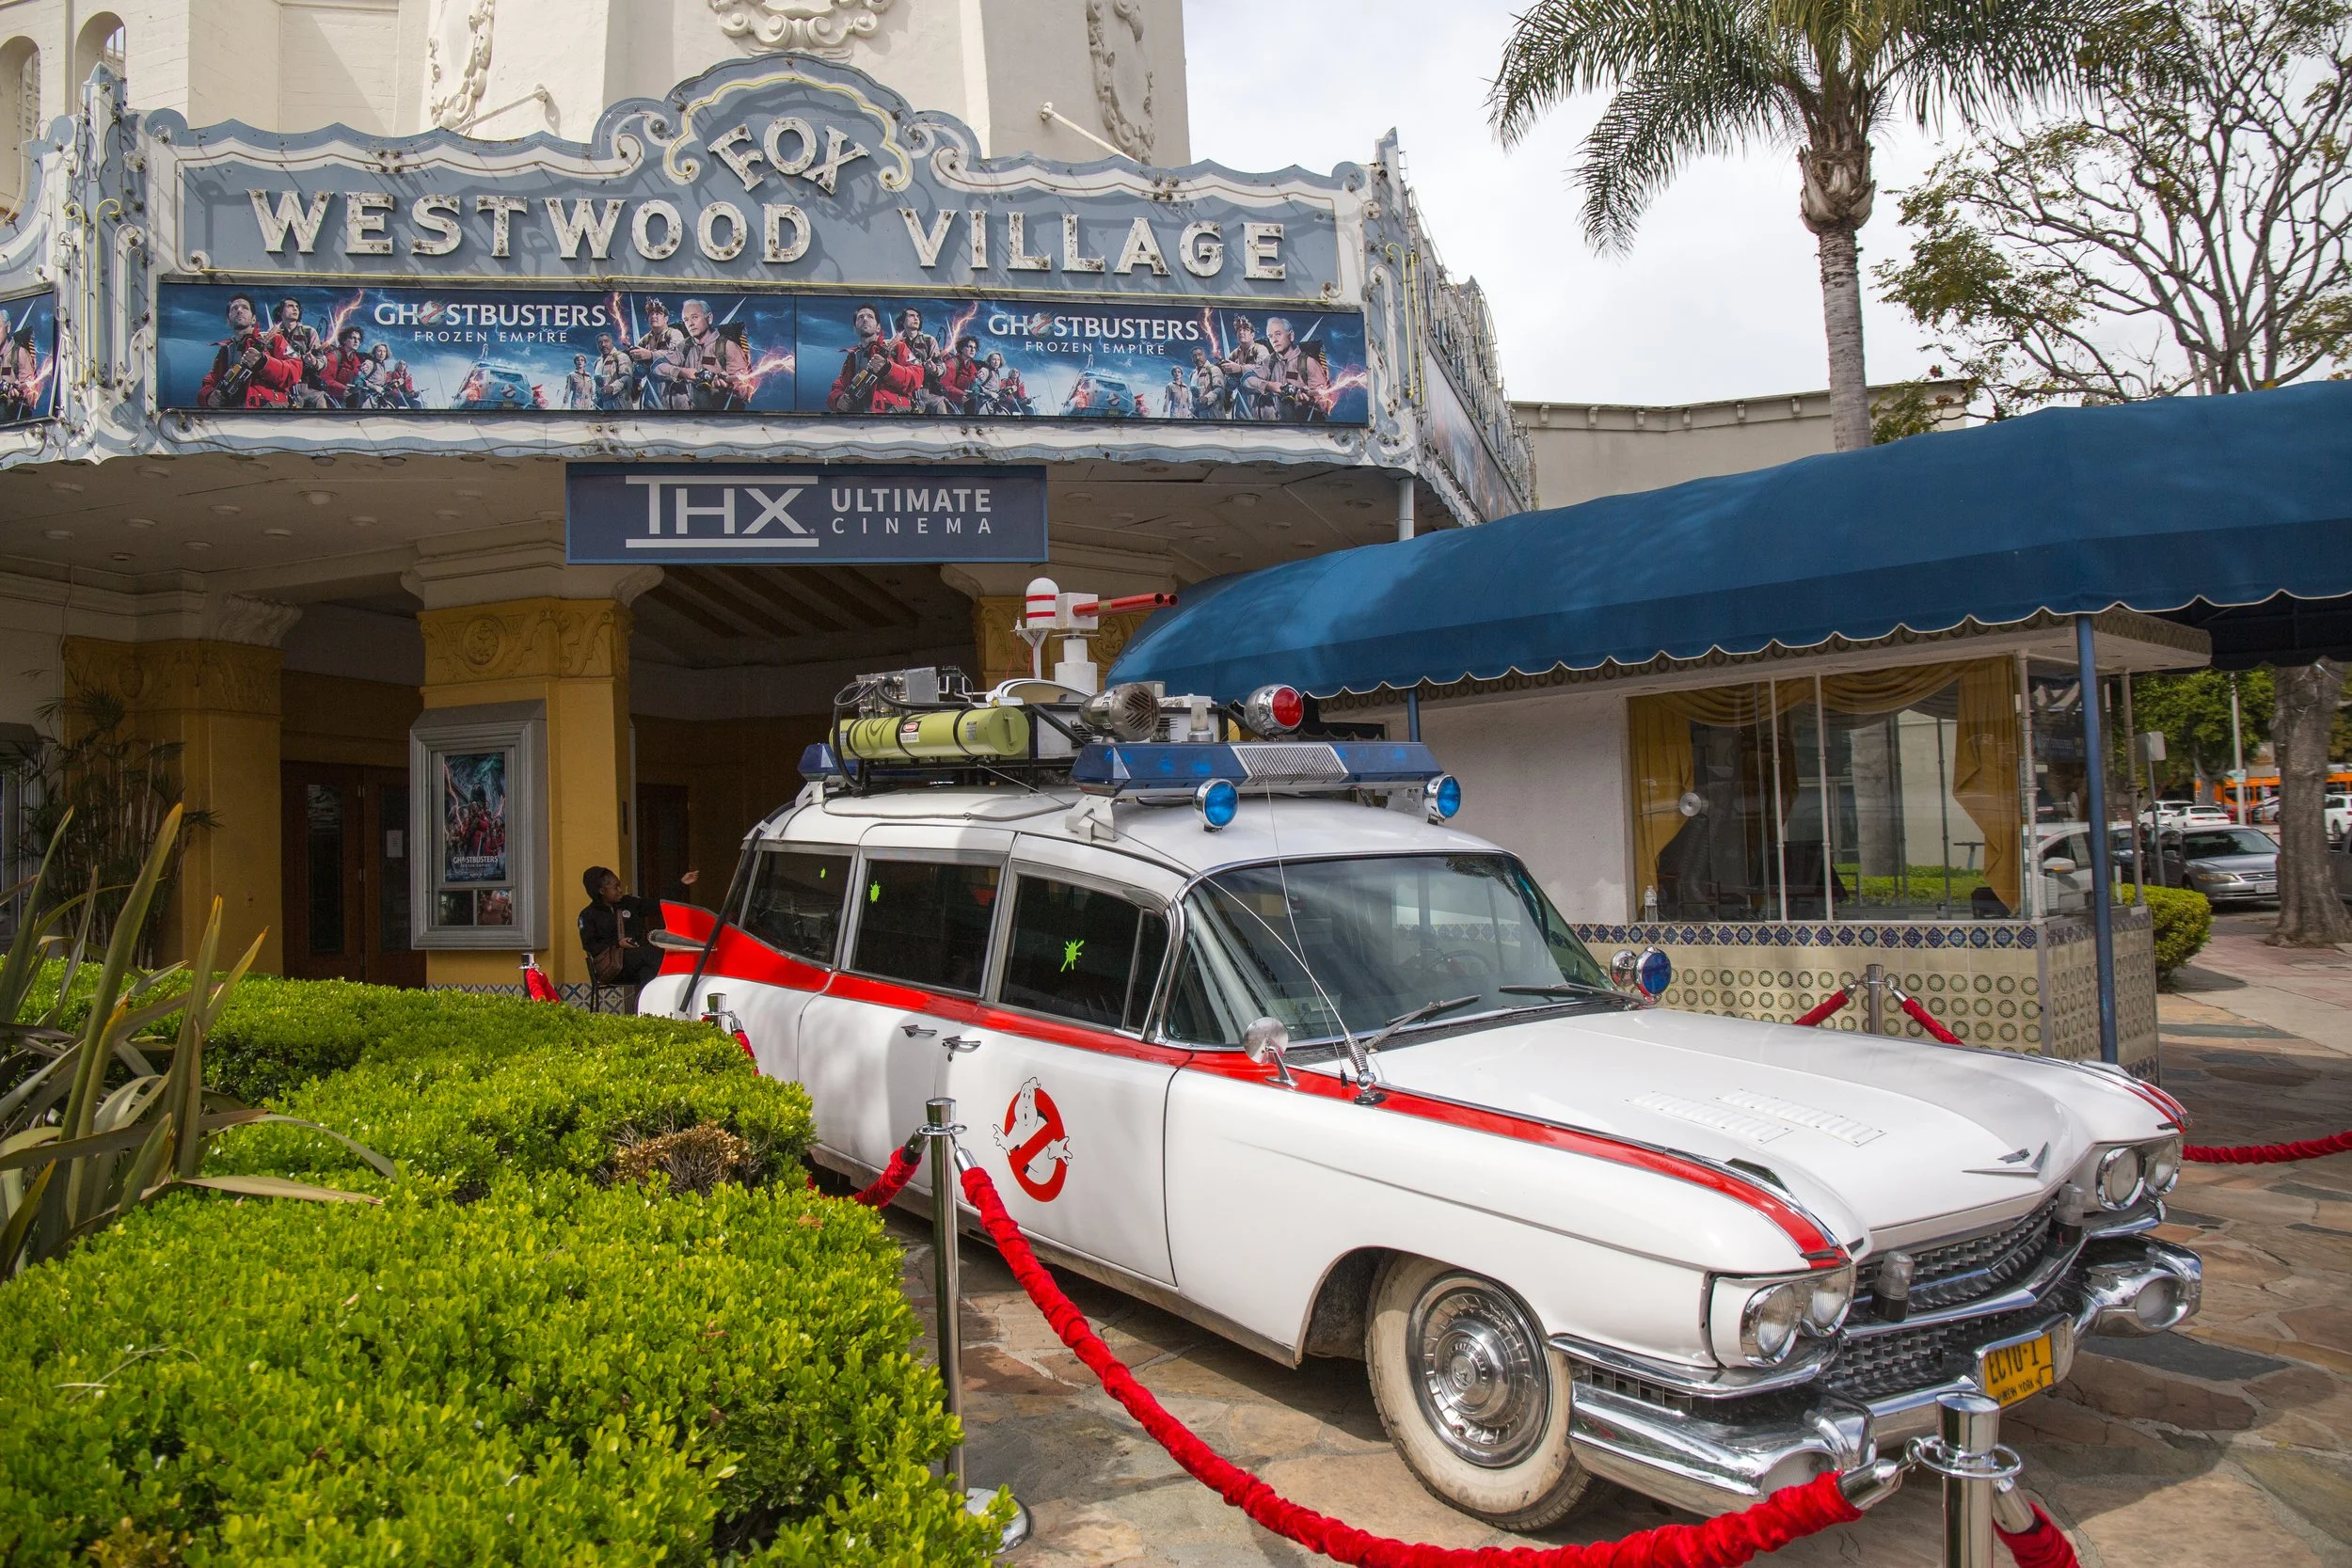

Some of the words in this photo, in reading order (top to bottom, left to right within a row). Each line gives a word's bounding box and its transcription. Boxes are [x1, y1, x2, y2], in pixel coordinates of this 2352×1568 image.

[707, 117, 870, 195] FOX
[246, 187, 812, 263] WESTWOOD
[898, 207, 1287, 281] VILLAGE
[414, 331, 488, 342] FROZEN
[500, 331, 567, 342] EMPIRE
[1025, 341, 1093, 353] FROZEN
[1103, 343, 1166, 356] EMPIRE
[626, 475, 818, 535] THX
[832, 487, 993, 514] ULTIMATE
[832, 516, 993, 535] CINEMA
[2002, 1386, 2018, 1401] NEW
[2018, 1378, 2035, 1392] YORK
